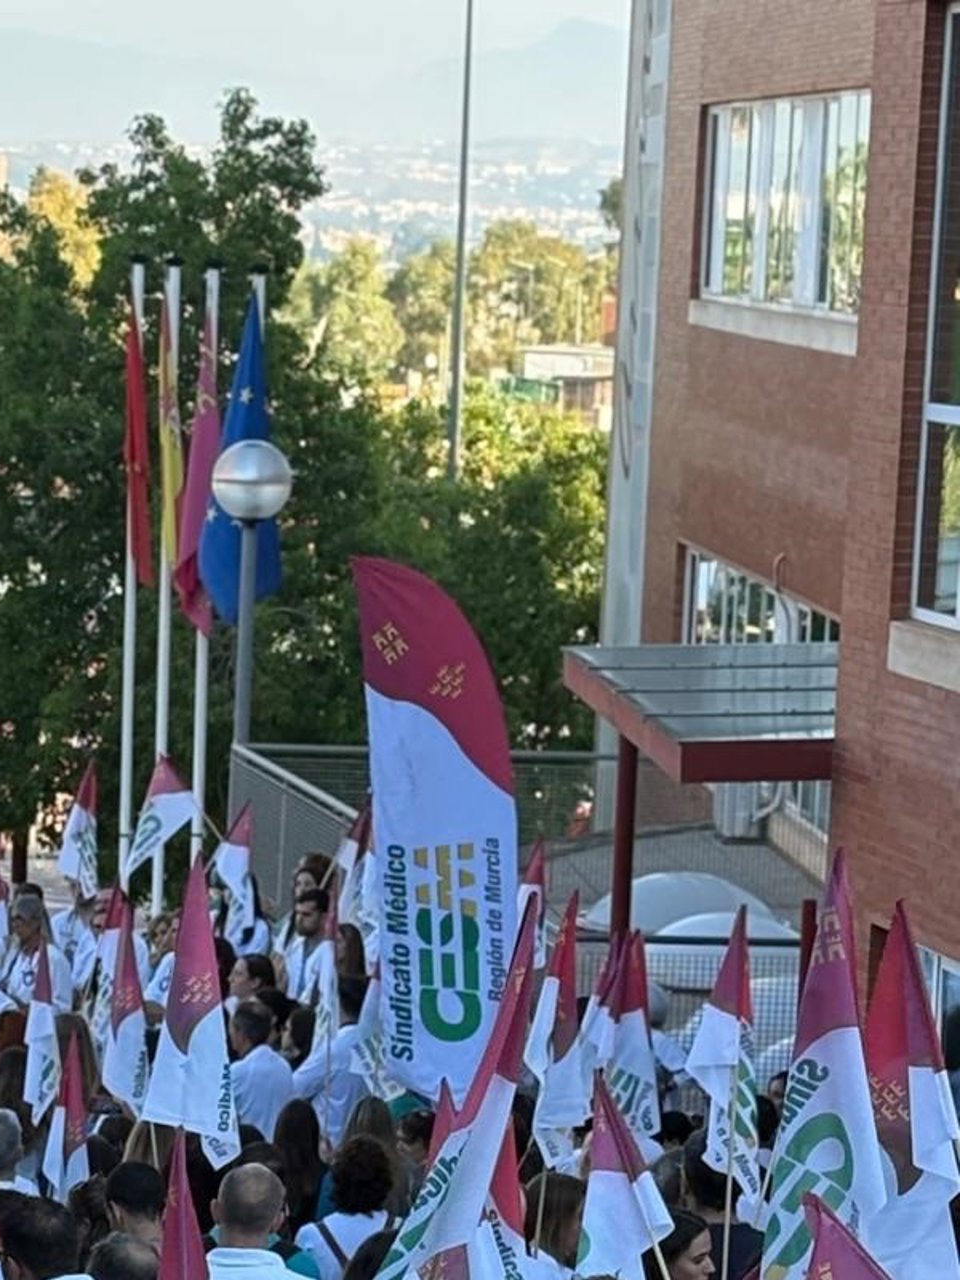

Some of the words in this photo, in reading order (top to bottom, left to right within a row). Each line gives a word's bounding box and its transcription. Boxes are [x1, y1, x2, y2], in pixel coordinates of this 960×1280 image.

[384, 844, 409, 935] Médico
[483, 837, 501, 902] Murcia
[486, 909, 502, 931] de
[485, 937, 506, 1001] Región
[388, 942, 414, 1062] Sindicato
